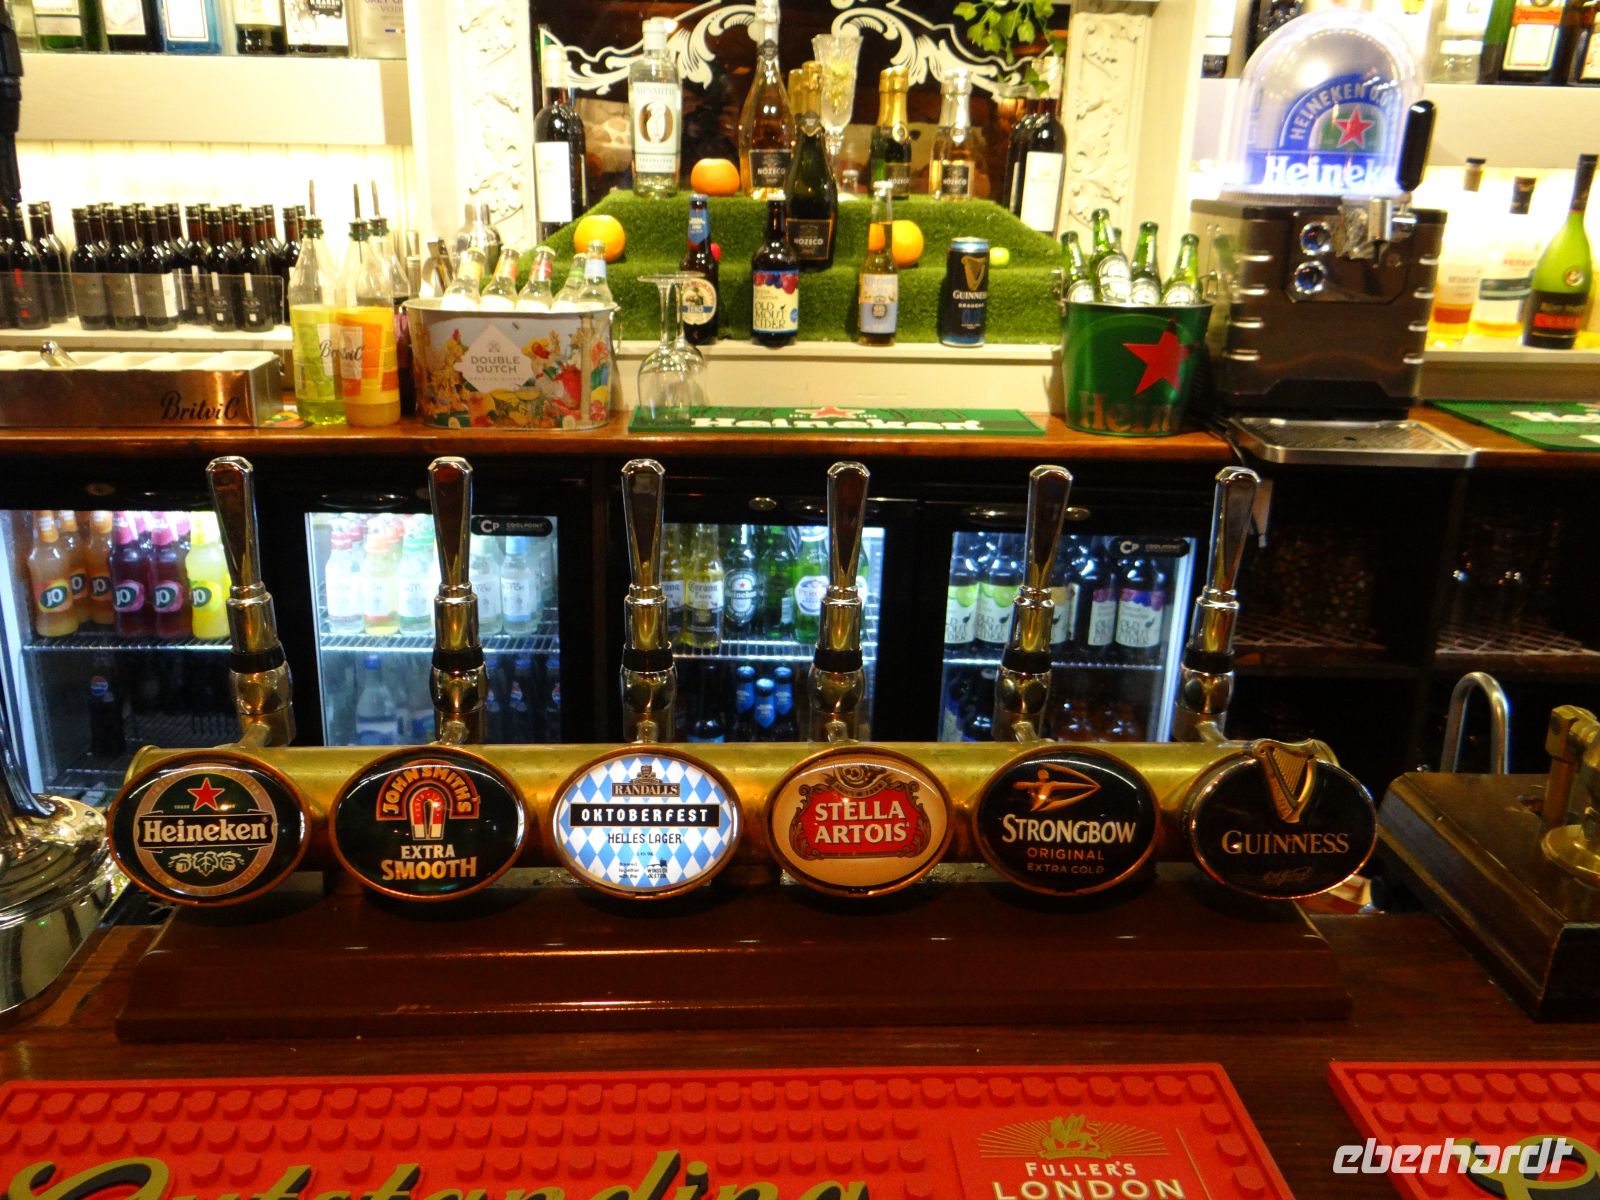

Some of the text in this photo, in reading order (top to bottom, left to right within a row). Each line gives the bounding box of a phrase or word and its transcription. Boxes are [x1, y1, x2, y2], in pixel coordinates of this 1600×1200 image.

[1289, 82, 1367, 141] HEINEKEN
[470, 356, 520, 364] DOUBLE
[476, 365, 517, 374] DUTCH
[382, 767, 420, 815] JOHN
[614, 784, 679, 796] RANDALLS
[581, 808, 708, 822] OKTOBERFEST
[815, 800, 906, 822] STELLA
[142, 818, 268, 843] Heineken
[607, 832, 682, 844] HELLES LAGER
[814, 823, 907, 844] ARTOIS
[1002, 813, 1137, 844] STRONGBOW
[1221, 829, 1350, 855] GUINNESS
[400, 844, 456, 860] EXTRA
[1027, 847, 1105, 861] ORIGINAL
[380, 856, 478, 881] SMOOTH
[1027, 863, 1105, 875] EXTRA COLD
[1025, 1160, 1137, 1178] FULLER'S
[992, 1178, 1187, 1200] LONDON
